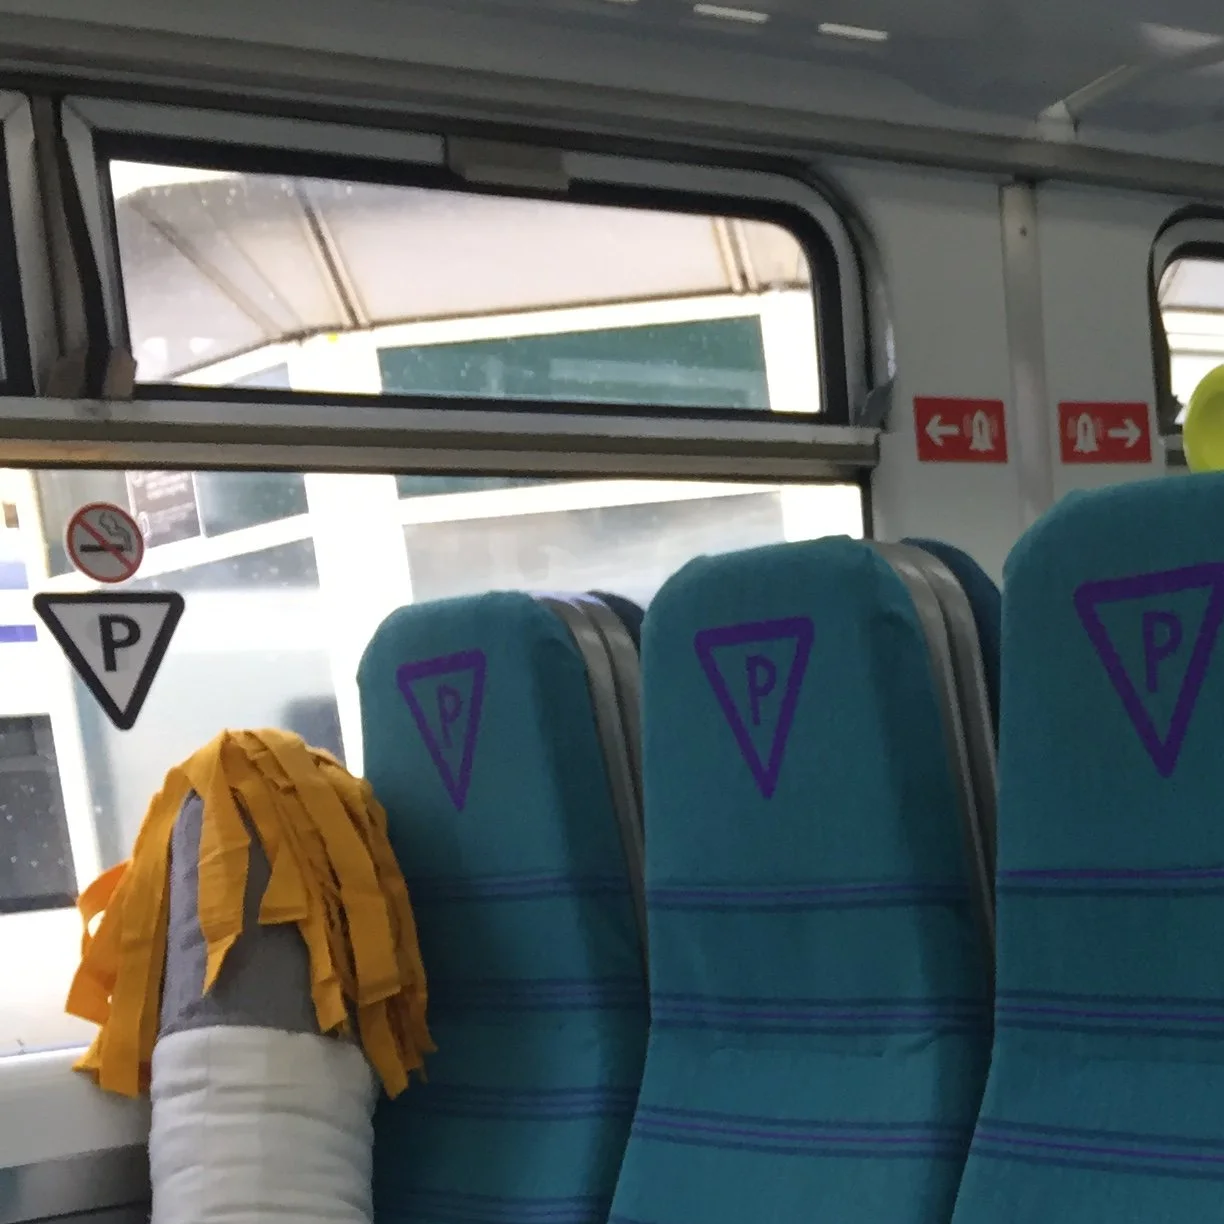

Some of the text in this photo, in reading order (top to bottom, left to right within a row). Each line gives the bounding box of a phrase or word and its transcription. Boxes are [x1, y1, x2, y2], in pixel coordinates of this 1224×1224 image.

[98, 613, 142, 672] P
[1143, 610, 1183, 693] P
[437, 684, 463, 749] P
[746, 653, 777, 726] P
